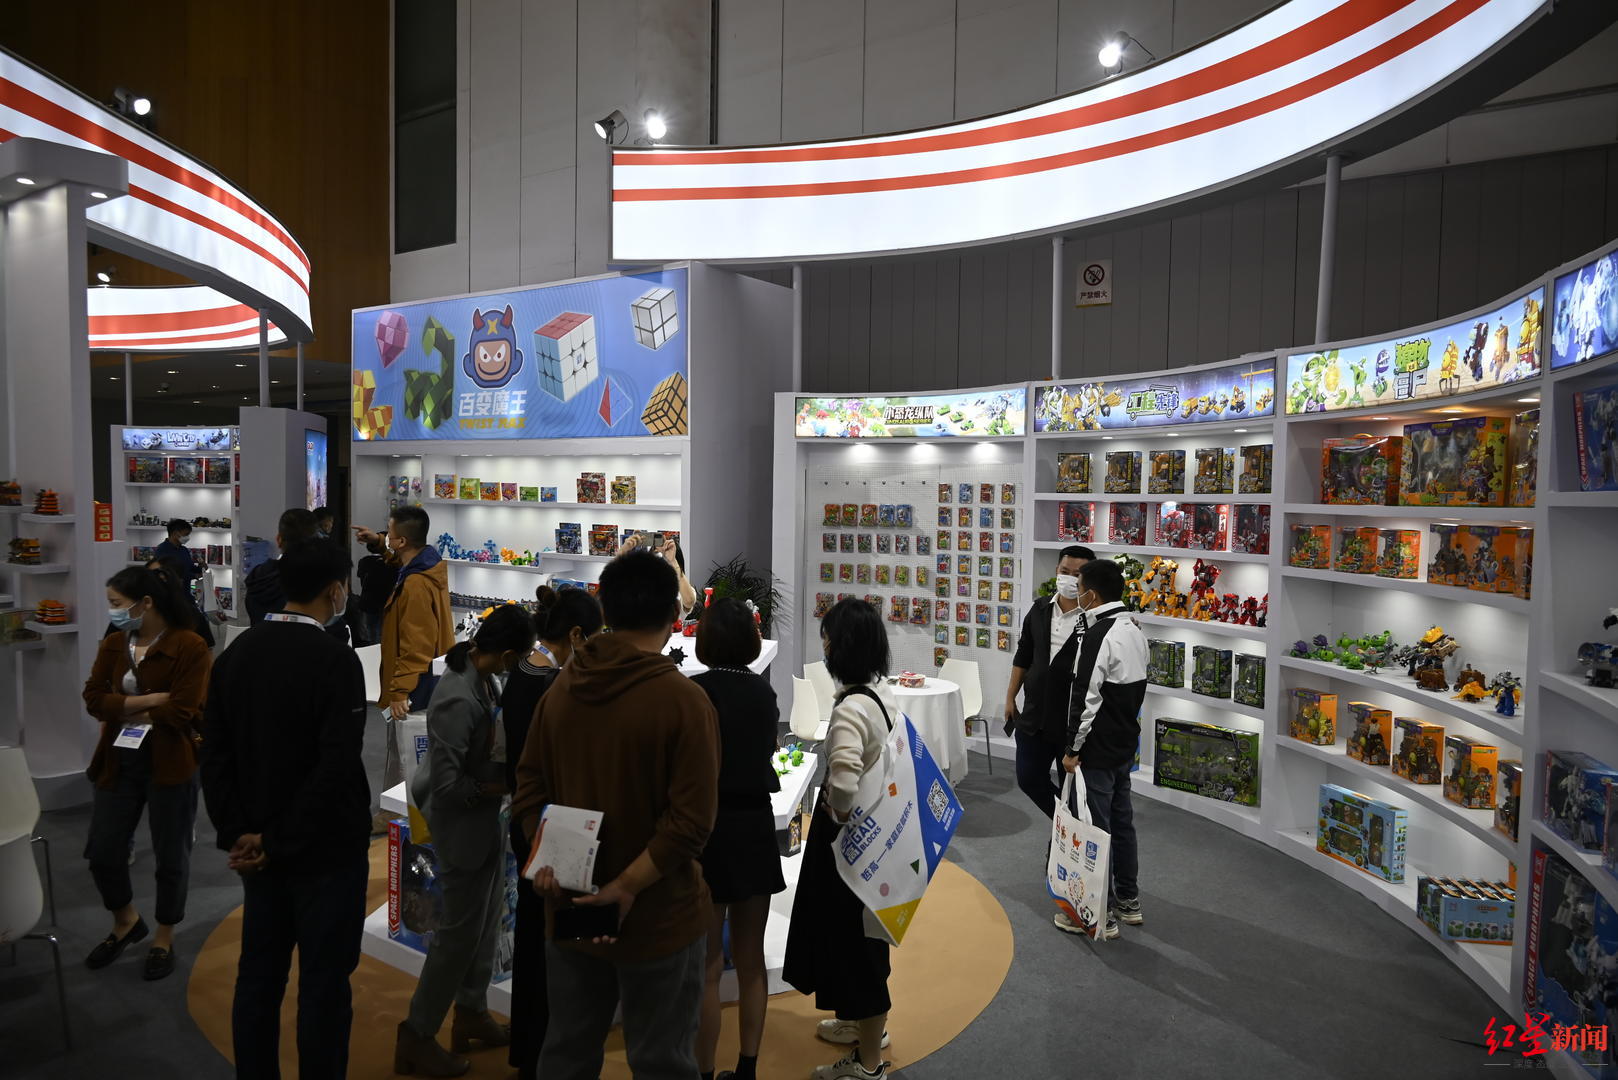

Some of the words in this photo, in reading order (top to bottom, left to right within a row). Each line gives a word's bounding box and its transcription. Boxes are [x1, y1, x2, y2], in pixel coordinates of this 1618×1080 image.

[1080, 290, 1108, 300] 严禁烟火
[459, 390, 527, 416] 百变魔王
[885, 406, 934, 420] 小恐龙纵队
[1127, 392, 1177, 412] 工程先锋
[851, 815, 877, 844] GAO
[860, 825, 882, 852] BLOCKS
[390, 844, 398, 892] MORPHERS
[390, 893, 398, 921] SPACE
[1530, 883, 1541, 954] MORPHERS
[1527, 956, 1536, 997] SPACE
